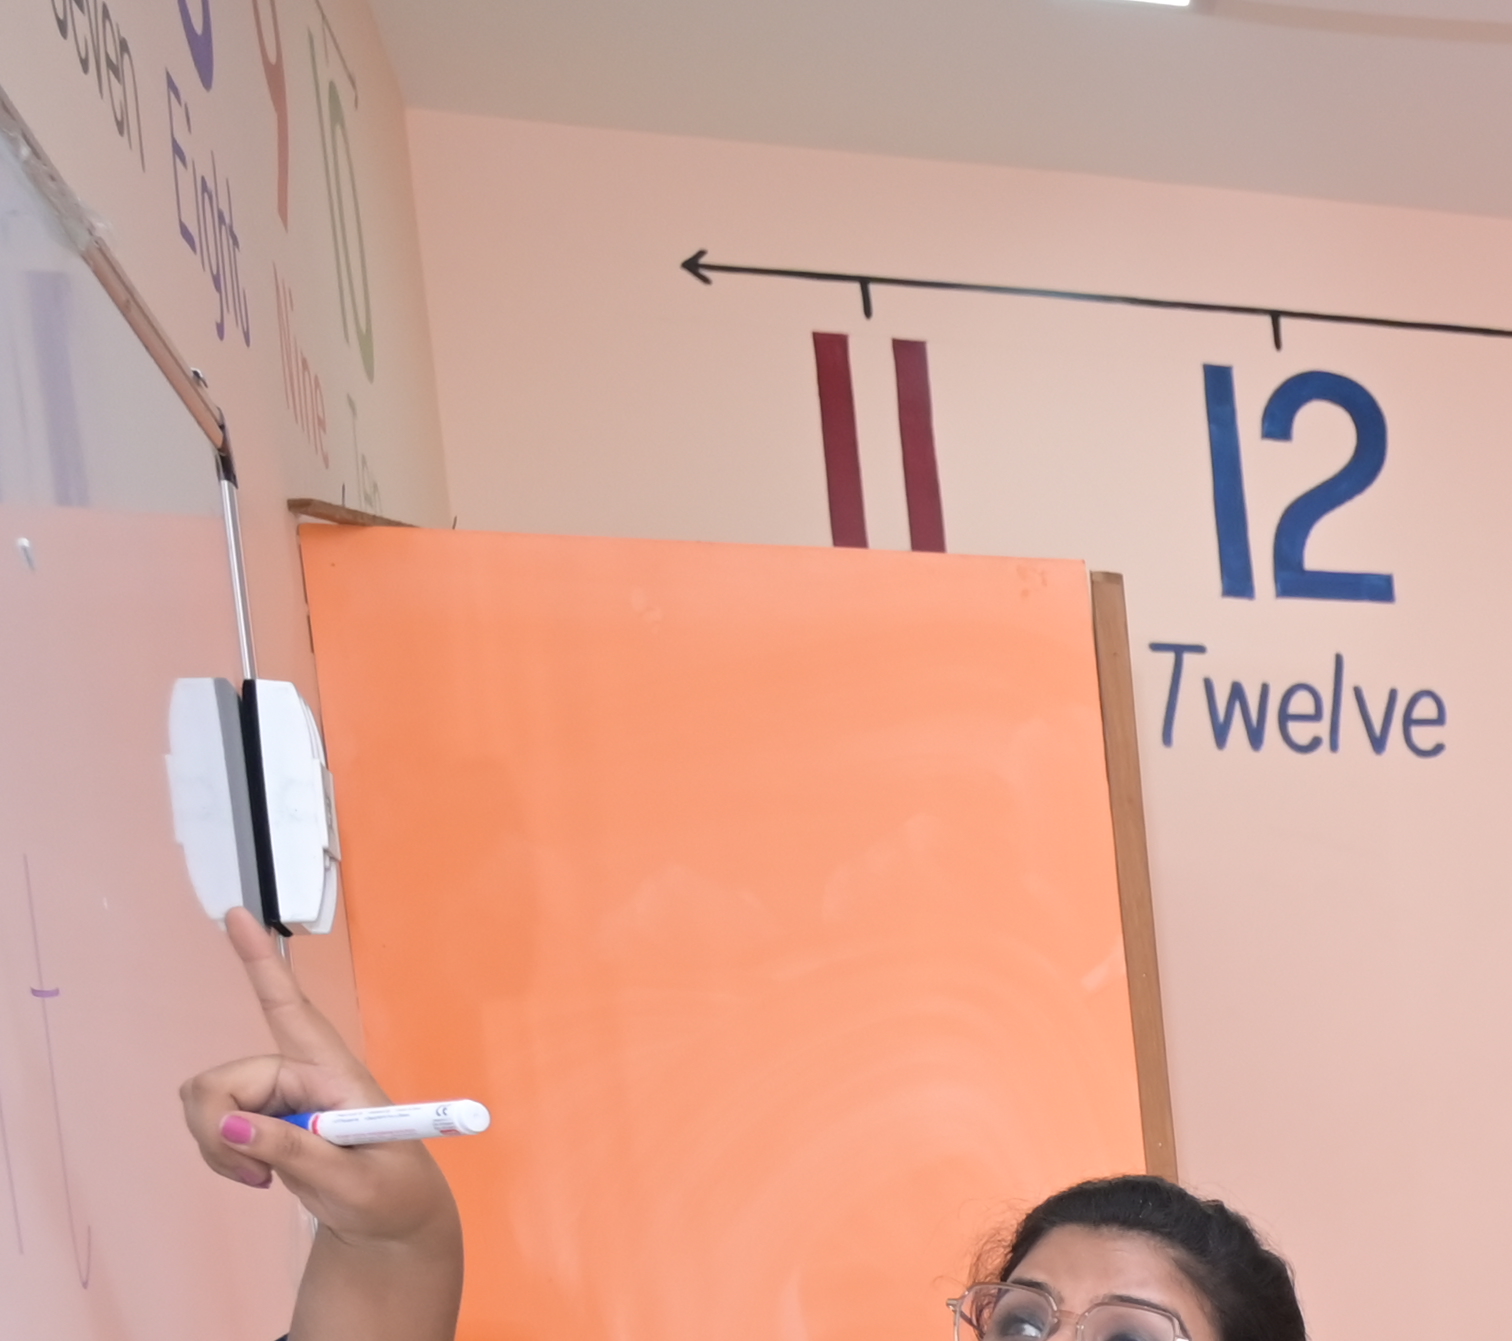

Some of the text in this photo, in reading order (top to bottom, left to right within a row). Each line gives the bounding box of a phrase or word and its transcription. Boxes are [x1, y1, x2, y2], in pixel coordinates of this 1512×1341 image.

[165, 66, 250, 349] Eight
[306, 26, 374, 384] 10
[272, 260, 329, 470] Nine
[346, 391, 384, 518] Ten
[812, 331, 946, 552] 11
[1203, 364, 1395, 603] 12
[1149, 642, 1446, 758] Twelve
